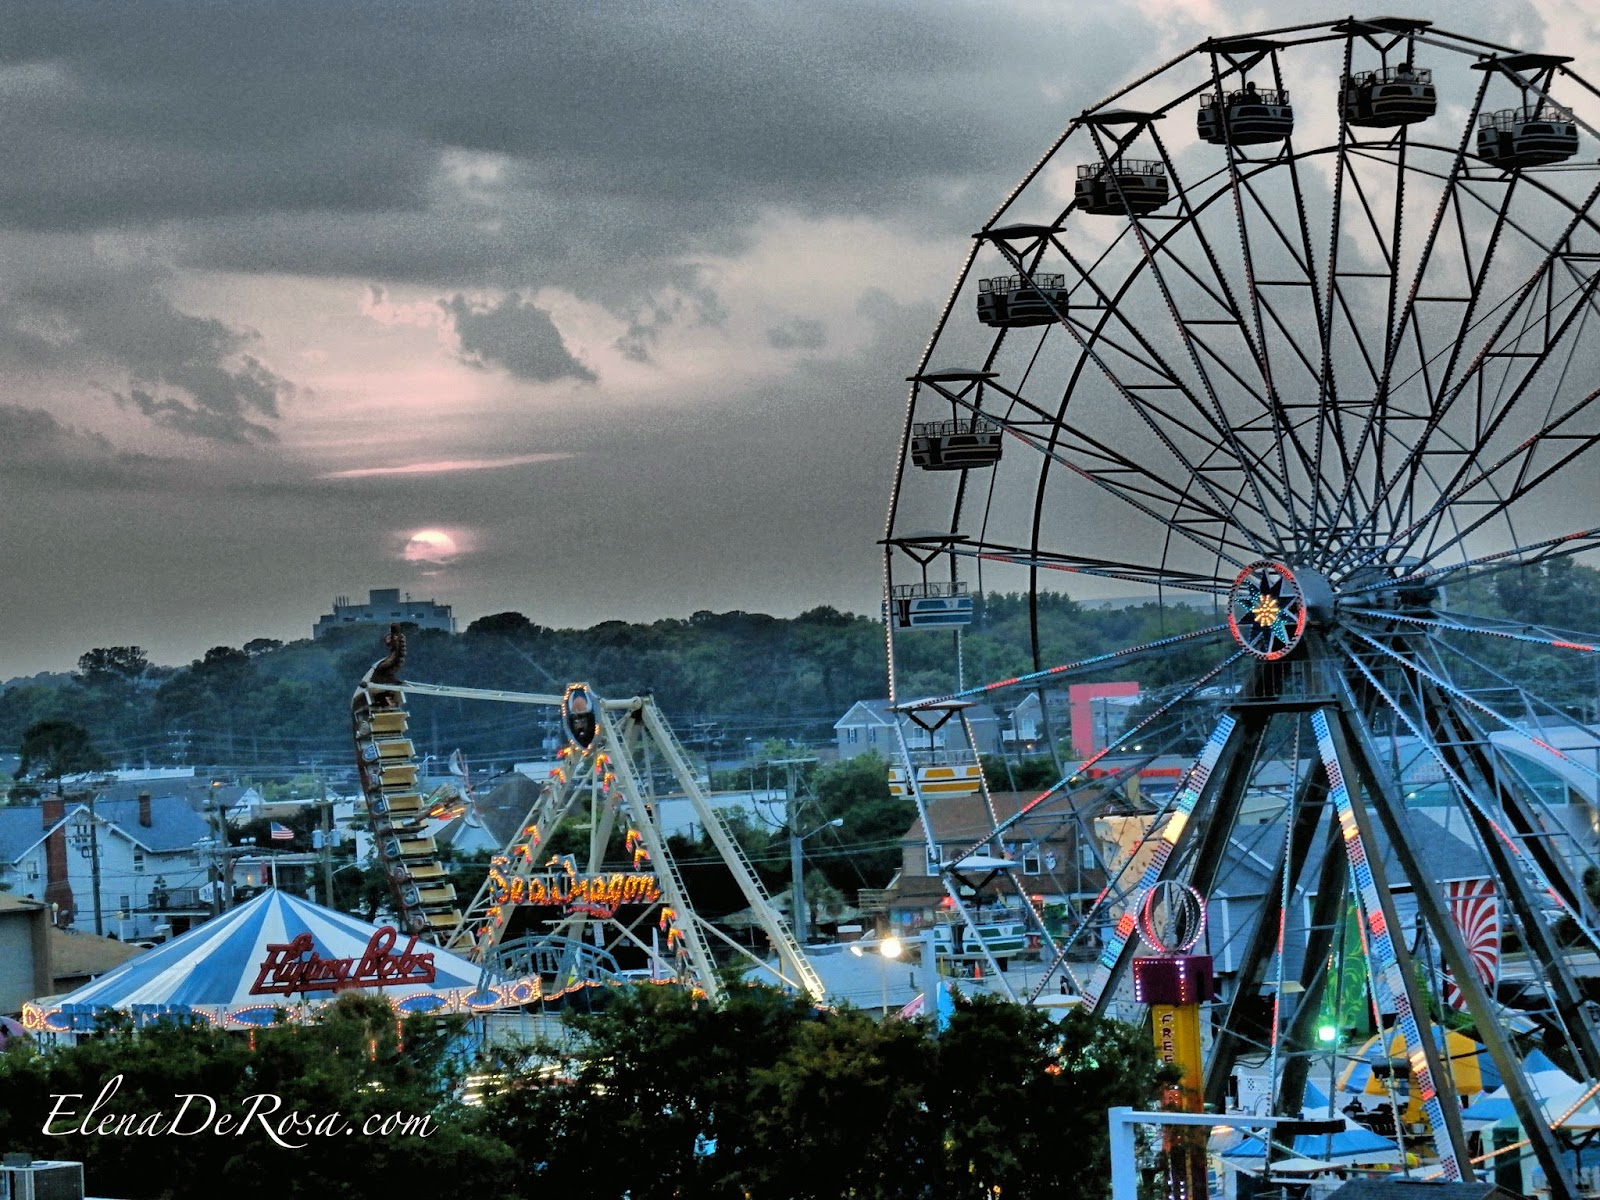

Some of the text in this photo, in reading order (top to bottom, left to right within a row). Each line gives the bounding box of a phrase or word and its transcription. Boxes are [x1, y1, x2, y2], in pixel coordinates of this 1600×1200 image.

[489, 854, 664, 919] Sea Dragon
[249, 926, 436, 997] Flying Bobs
